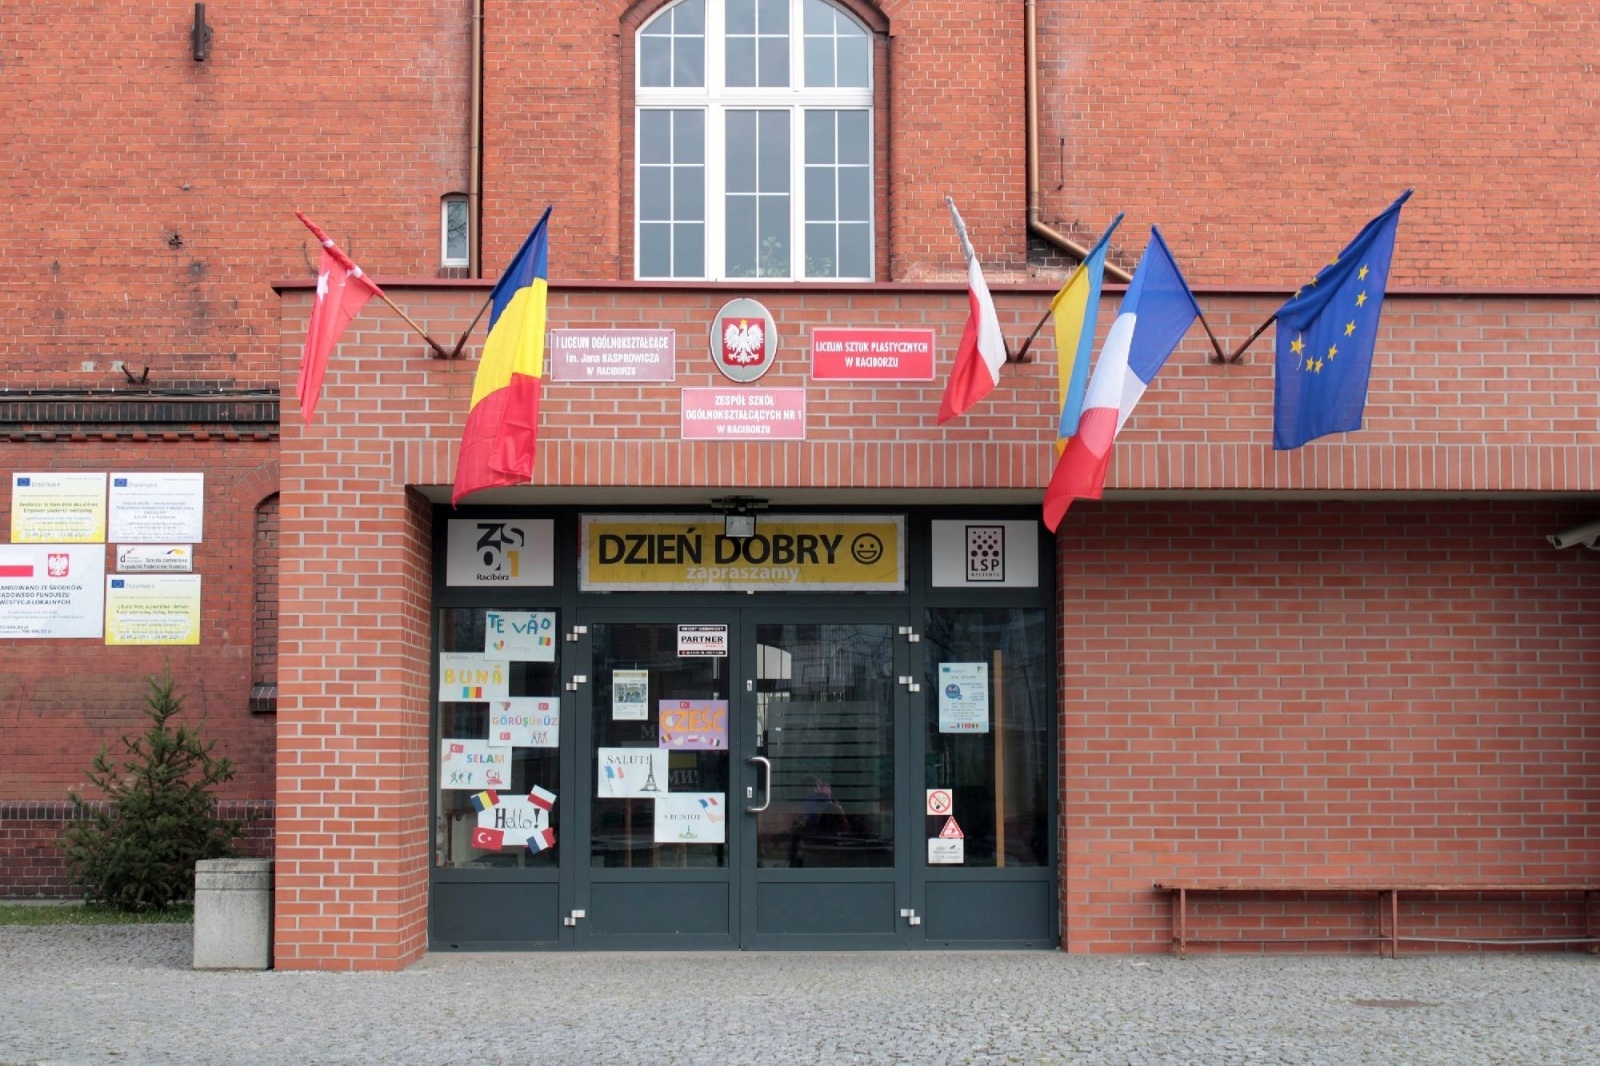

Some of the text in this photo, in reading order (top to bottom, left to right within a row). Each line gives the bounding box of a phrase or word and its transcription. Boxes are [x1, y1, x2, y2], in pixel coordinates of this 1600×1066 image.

[561, 336, 589, 349] LICEUM
[592, 334, 669, 351] OGÓLNOKSZTAŁCĄCE
[816, 342, 928, 353] LICEUM SZTUK PLASTYCZNYCH
[580, 354, 600, 363] Jana
[602, 353, 660, 363] KASPROWICZA
[845, 357, 898, 367] W RACIBORZU
[586, 366, 636, 376] W RACIBORZU
[714, 394, 775, 406] ZESPÓŁ SZKÓŁ
[686, 408, 802, 422] OGÓLNOKSZTAŁCĄCYCH NR 1
[717, 425, 770, 434] W RACIBORZU
[598, 528, 844, 564] DZIEŃ DOBRY
[971, 558, 1000, 571] LSP
[686, 564, 801, 582] zapraszamy
[488, 614, 504, 633] TE
[466, 754, 505, 763] SELAM
[606, 754, 649, 764] SALUT!
[495, 808, 541, 829] Hello!
